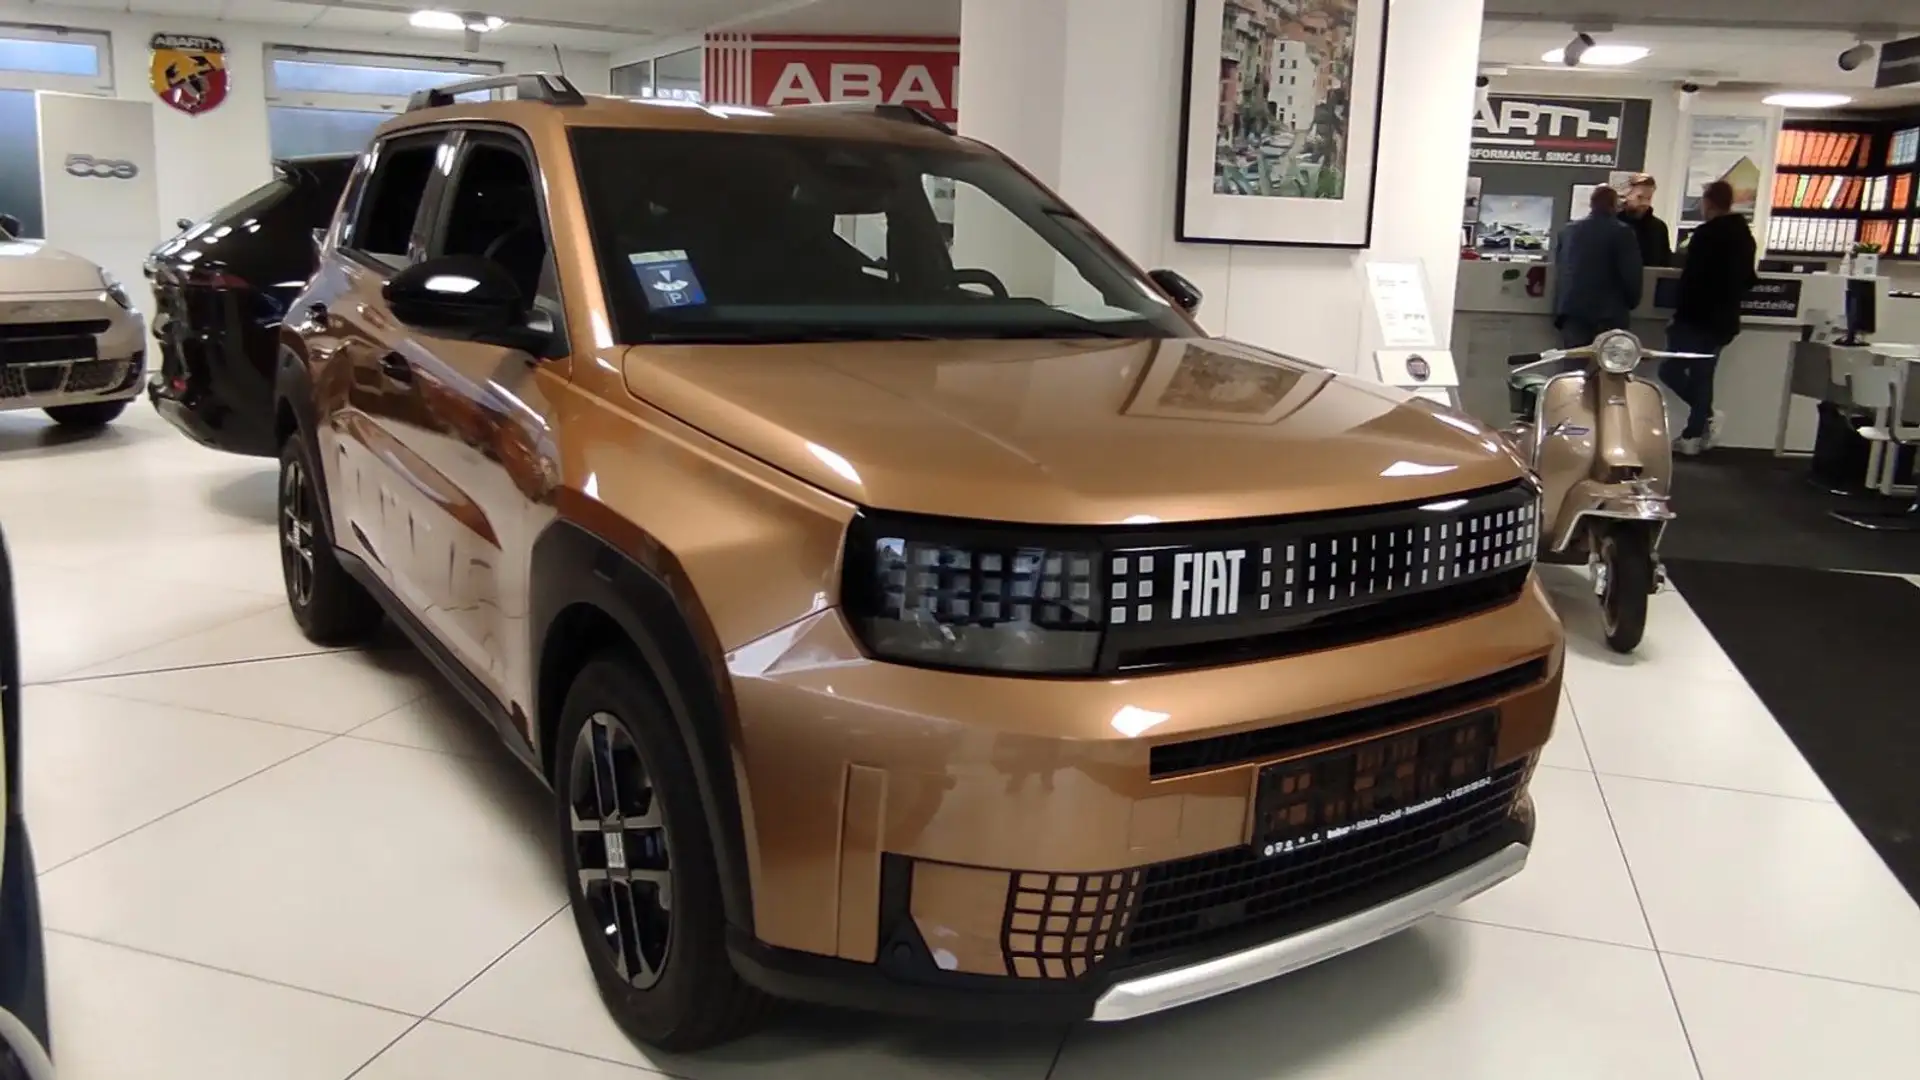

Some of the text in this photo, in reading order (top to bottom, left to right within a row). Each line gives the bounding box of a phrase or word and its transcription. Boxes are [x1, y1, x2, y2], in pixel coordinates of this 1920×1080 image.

[155, 36, 222, 51] ABARTH
[1546, 151, 1581, 162] SINCE
[1171, 549, 1246, 620] FIAT
